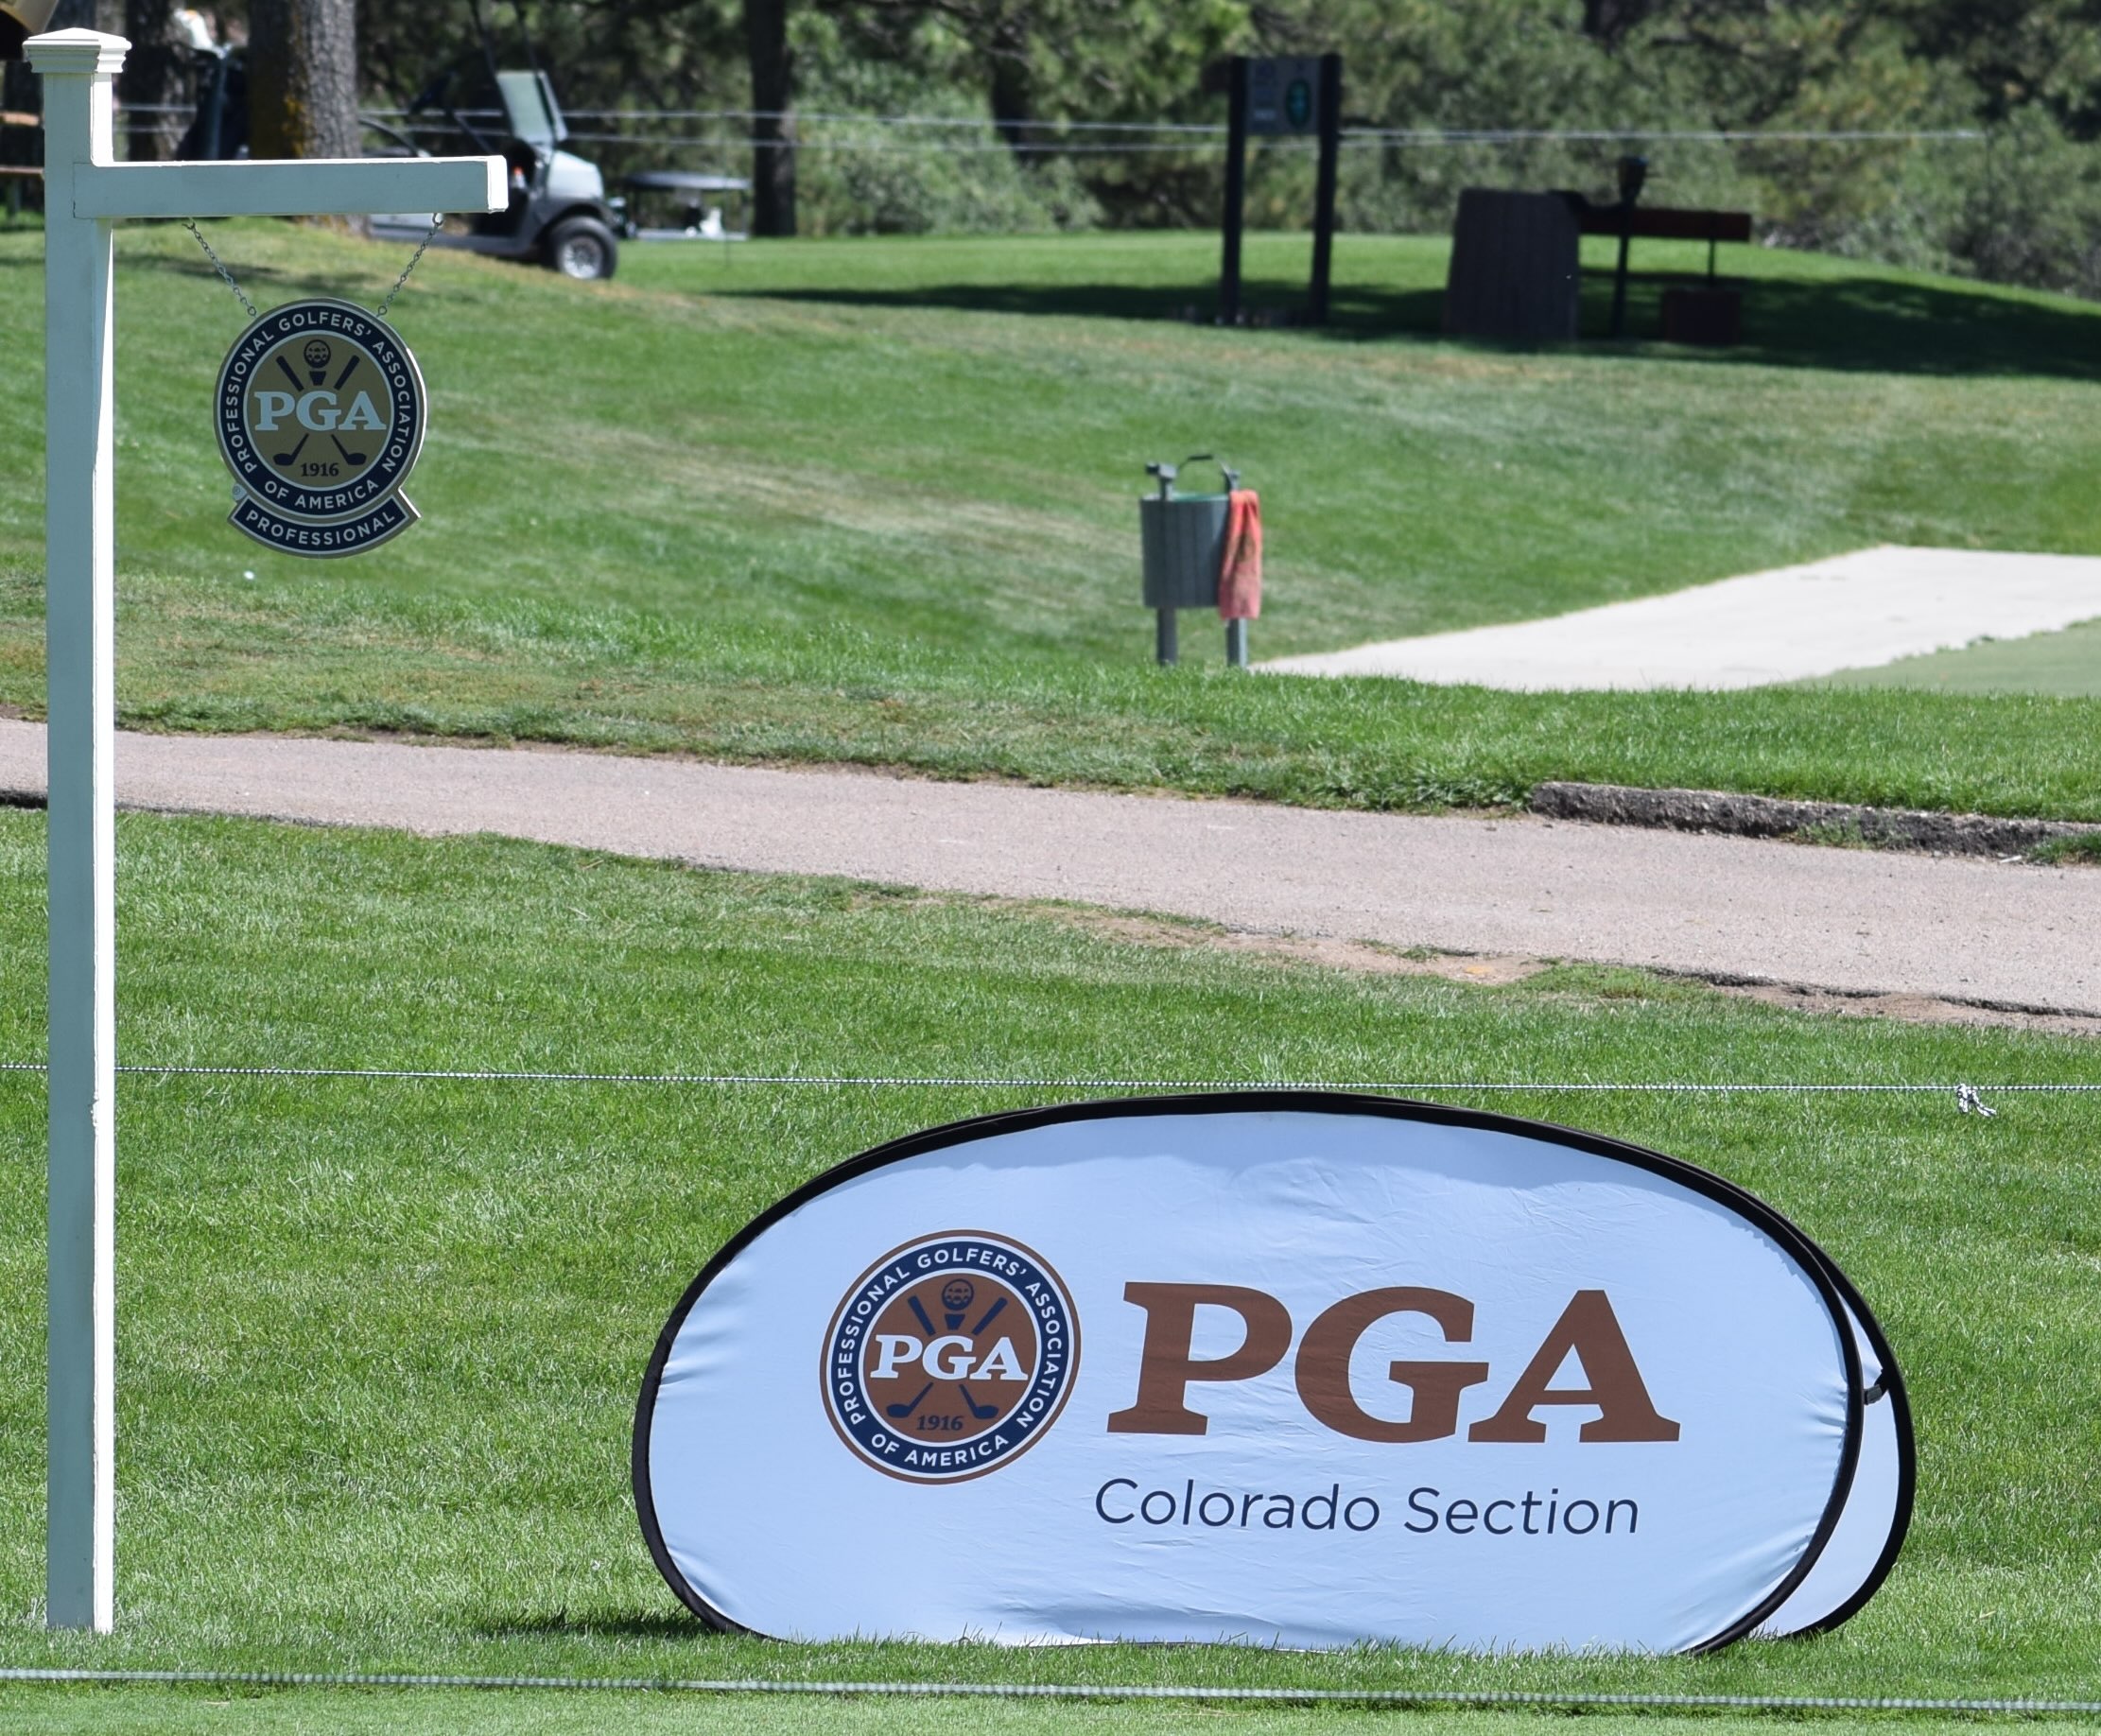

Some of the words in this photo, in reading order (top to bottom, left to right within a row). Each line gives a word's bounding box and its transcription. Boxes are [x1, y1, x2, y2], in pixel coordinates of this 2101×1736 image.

[225, 330, 274, 474] PROFESSIONAL
[372, 340, 411, 473] ASSOCIATION
[253, 391, 387, 431] PGA
[301, 462, 339, 477] 1916
[265, 480, 290, 499] OF
[294, 479, 379, 510] AMERICA
[245, 509, 395, 546] PROFESSIONAL
[838, 1265, 911, 1425] PROFESSIONAL
[1016, 1281, 1062, 1429] ASSOCIATION
[870, 1334, 1029, 1381] PGA
[1106, 1281, 1681, 1444] PGA
[916, 1415, 964, 1432] 1916
[871, 1432, 900, 1455] OF
[904, 1434, 1009, 1467] AMERICA
[1095, 1478, 1380, 1533] Colorado
[1402, 1486, 1640, 1536] Section
